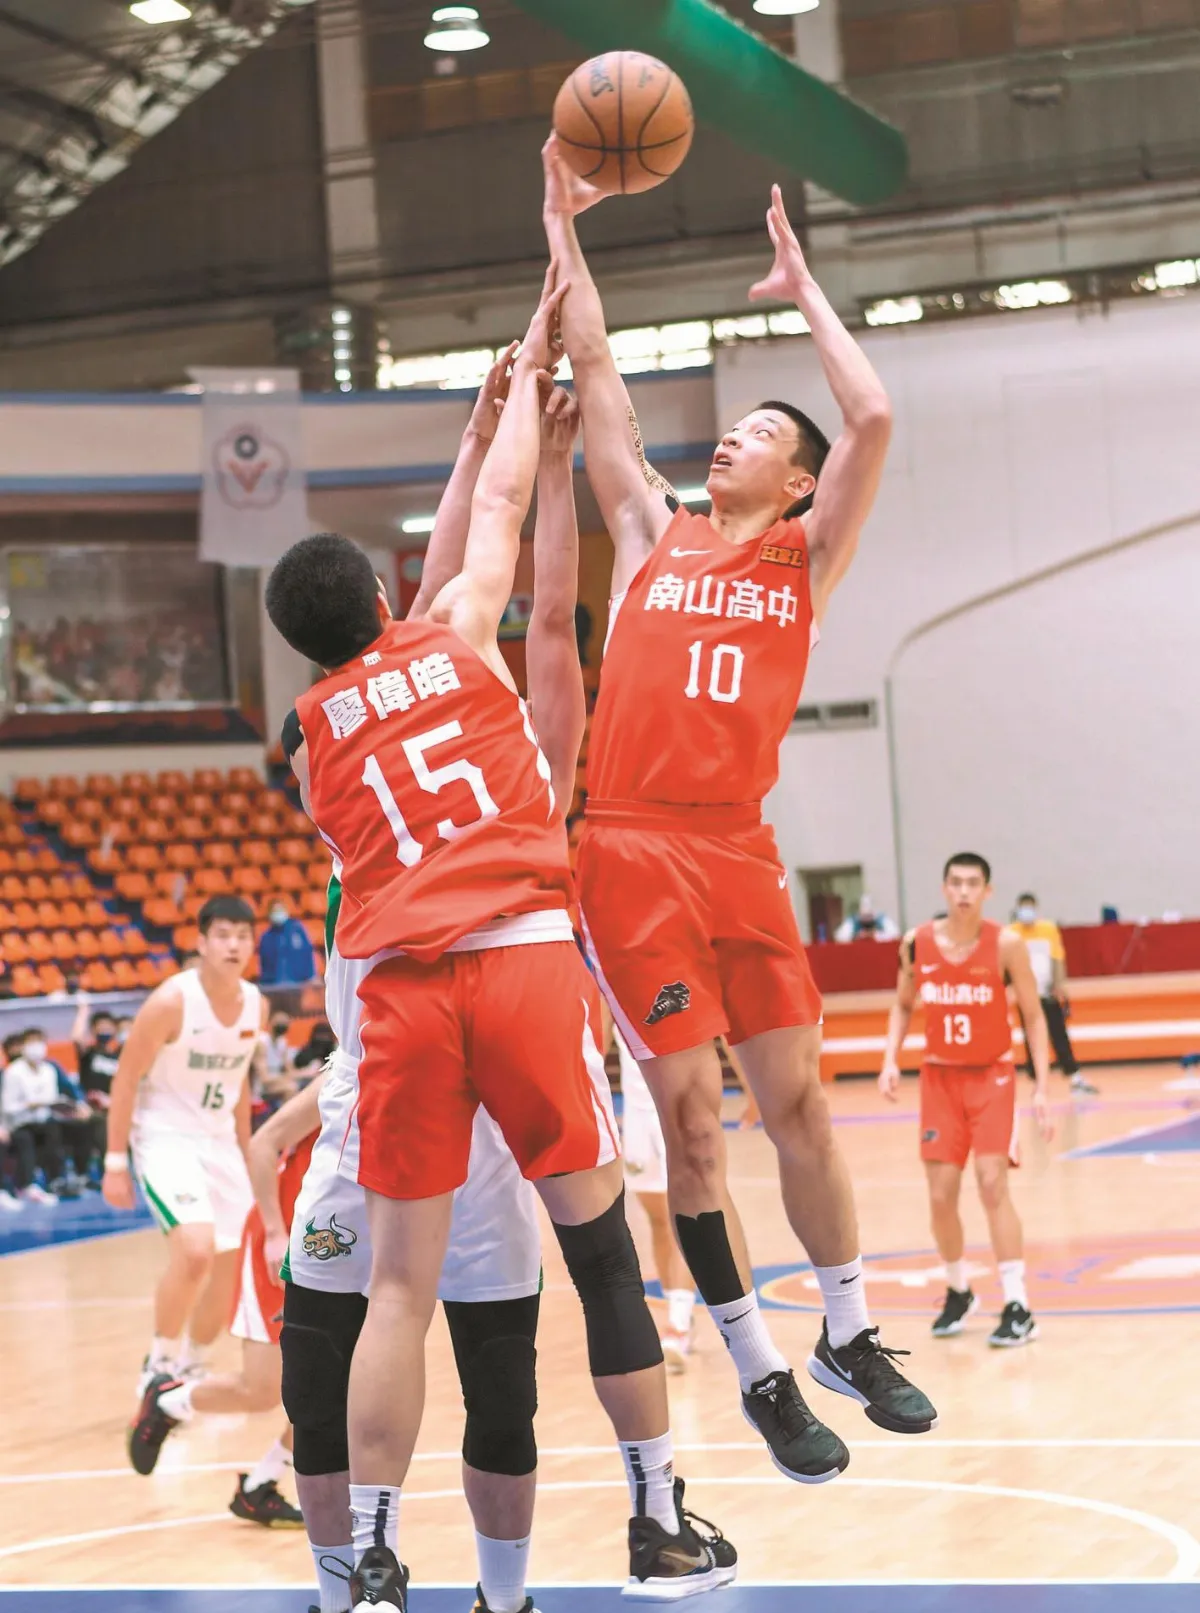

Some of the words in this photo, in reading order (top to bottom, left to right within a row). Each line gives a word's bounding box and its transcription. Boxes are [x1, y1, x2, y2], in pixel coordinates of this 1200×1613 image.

[760, 545, 802, 568] HBL
[644, 573, 798, 628] 南山高中
[320, 652, 462, 740] 廖偉皓
[684, 640, 745, 704] 10
[361, 719, 501, 868] 15
[943, 1014, 971, 1045] 13
[201, 1082, 225, 1109] 15
